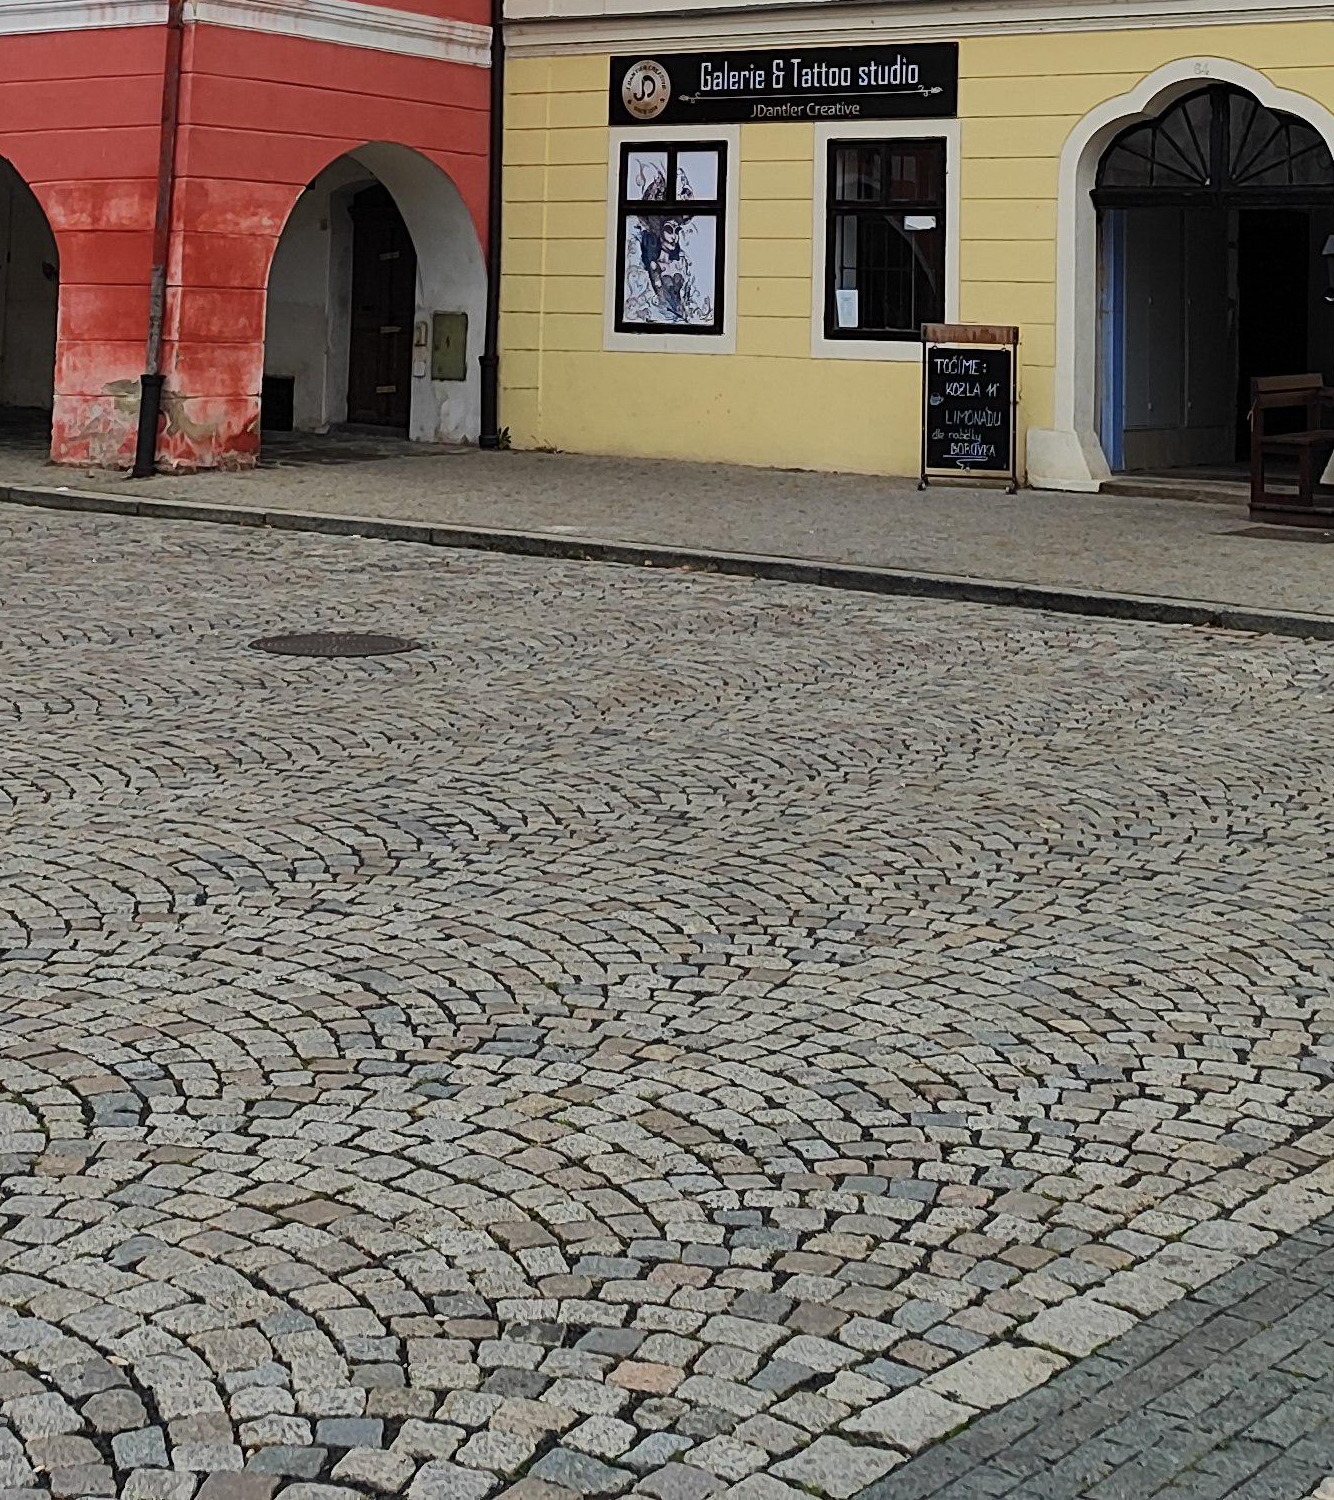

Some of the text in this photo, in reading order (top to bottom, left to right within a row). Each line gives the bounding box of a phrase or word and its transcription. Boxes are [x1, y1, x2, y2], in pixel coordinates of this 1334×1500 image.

[700, 54, 919, 91] Galerie & Tattoo studio
[807, 101, 860, 116] Creative
[945, 382, 981, 397] KOZLA
